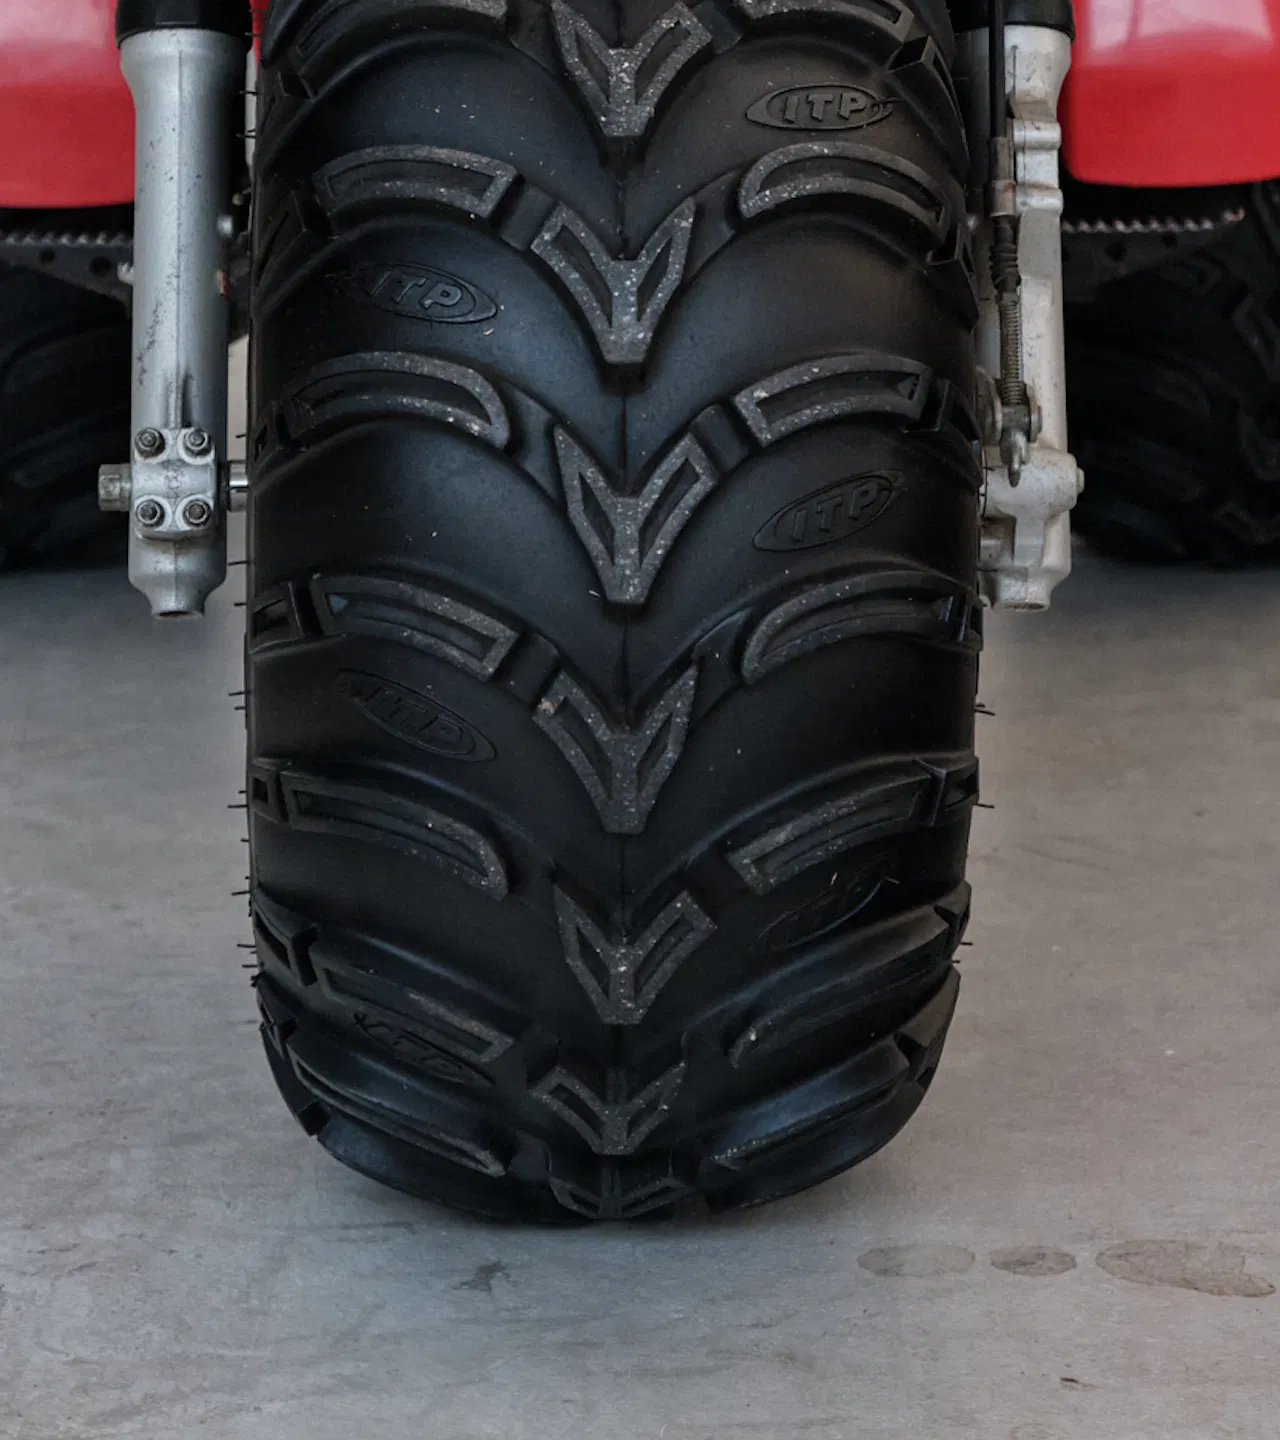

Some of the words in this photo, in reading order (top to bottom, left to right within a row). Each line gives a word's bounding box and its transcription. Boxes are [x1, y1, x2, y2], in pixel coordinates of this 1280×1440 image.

[783, 91, 869, 123] ITP
[368, 271, 463, 310] ITP
[791, 480, 879, 542] ITP
